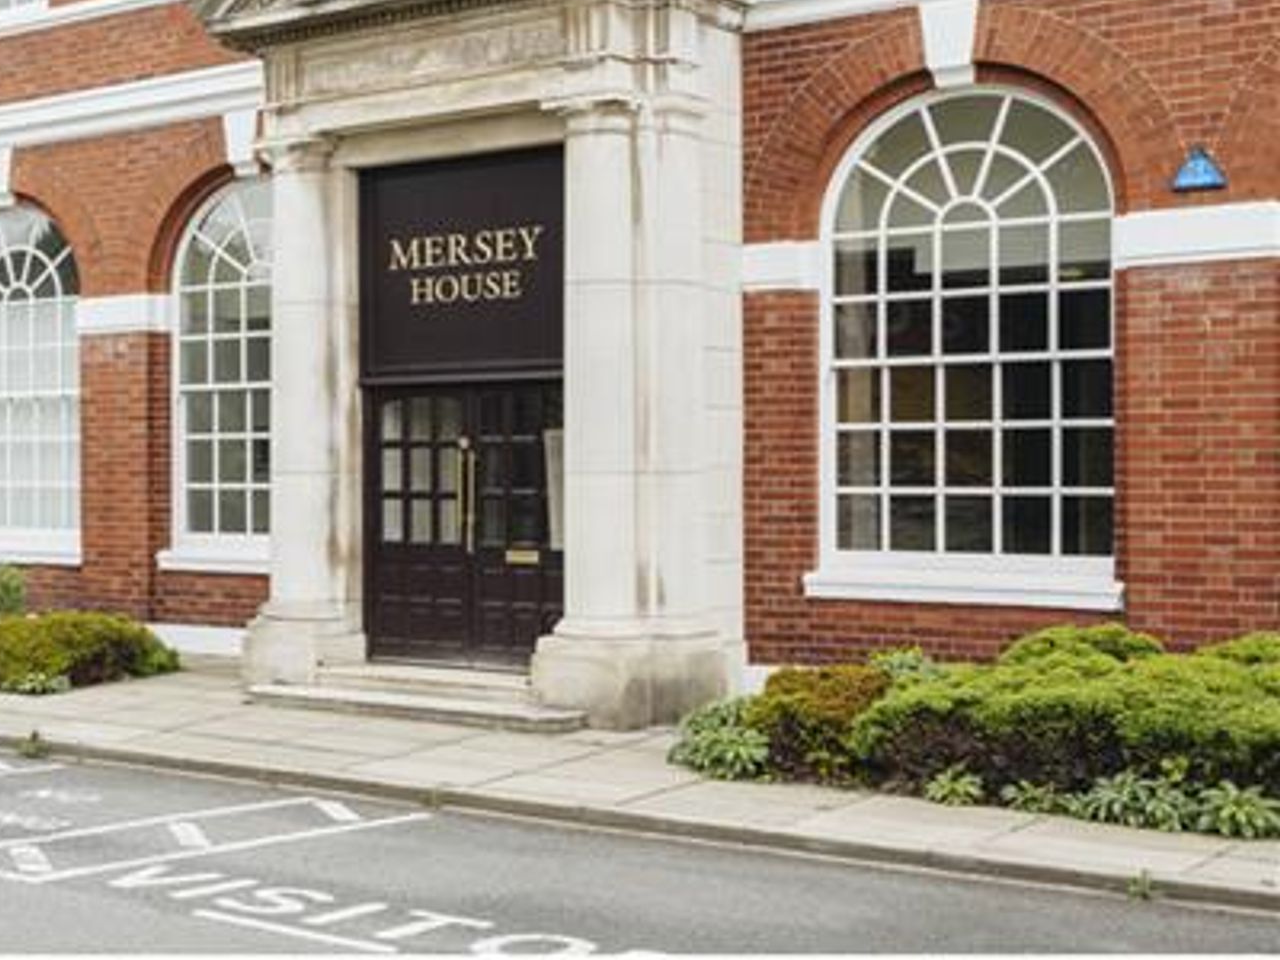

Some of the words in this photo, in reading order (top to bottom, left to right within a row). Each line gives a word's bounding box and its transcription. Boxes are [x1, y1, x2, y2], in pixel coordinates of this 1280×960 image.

[388, 226, 542, 270] MERSEY
[410, 271, 522, 304] HOUSE
[109, 864, 665, 954] VISITO
